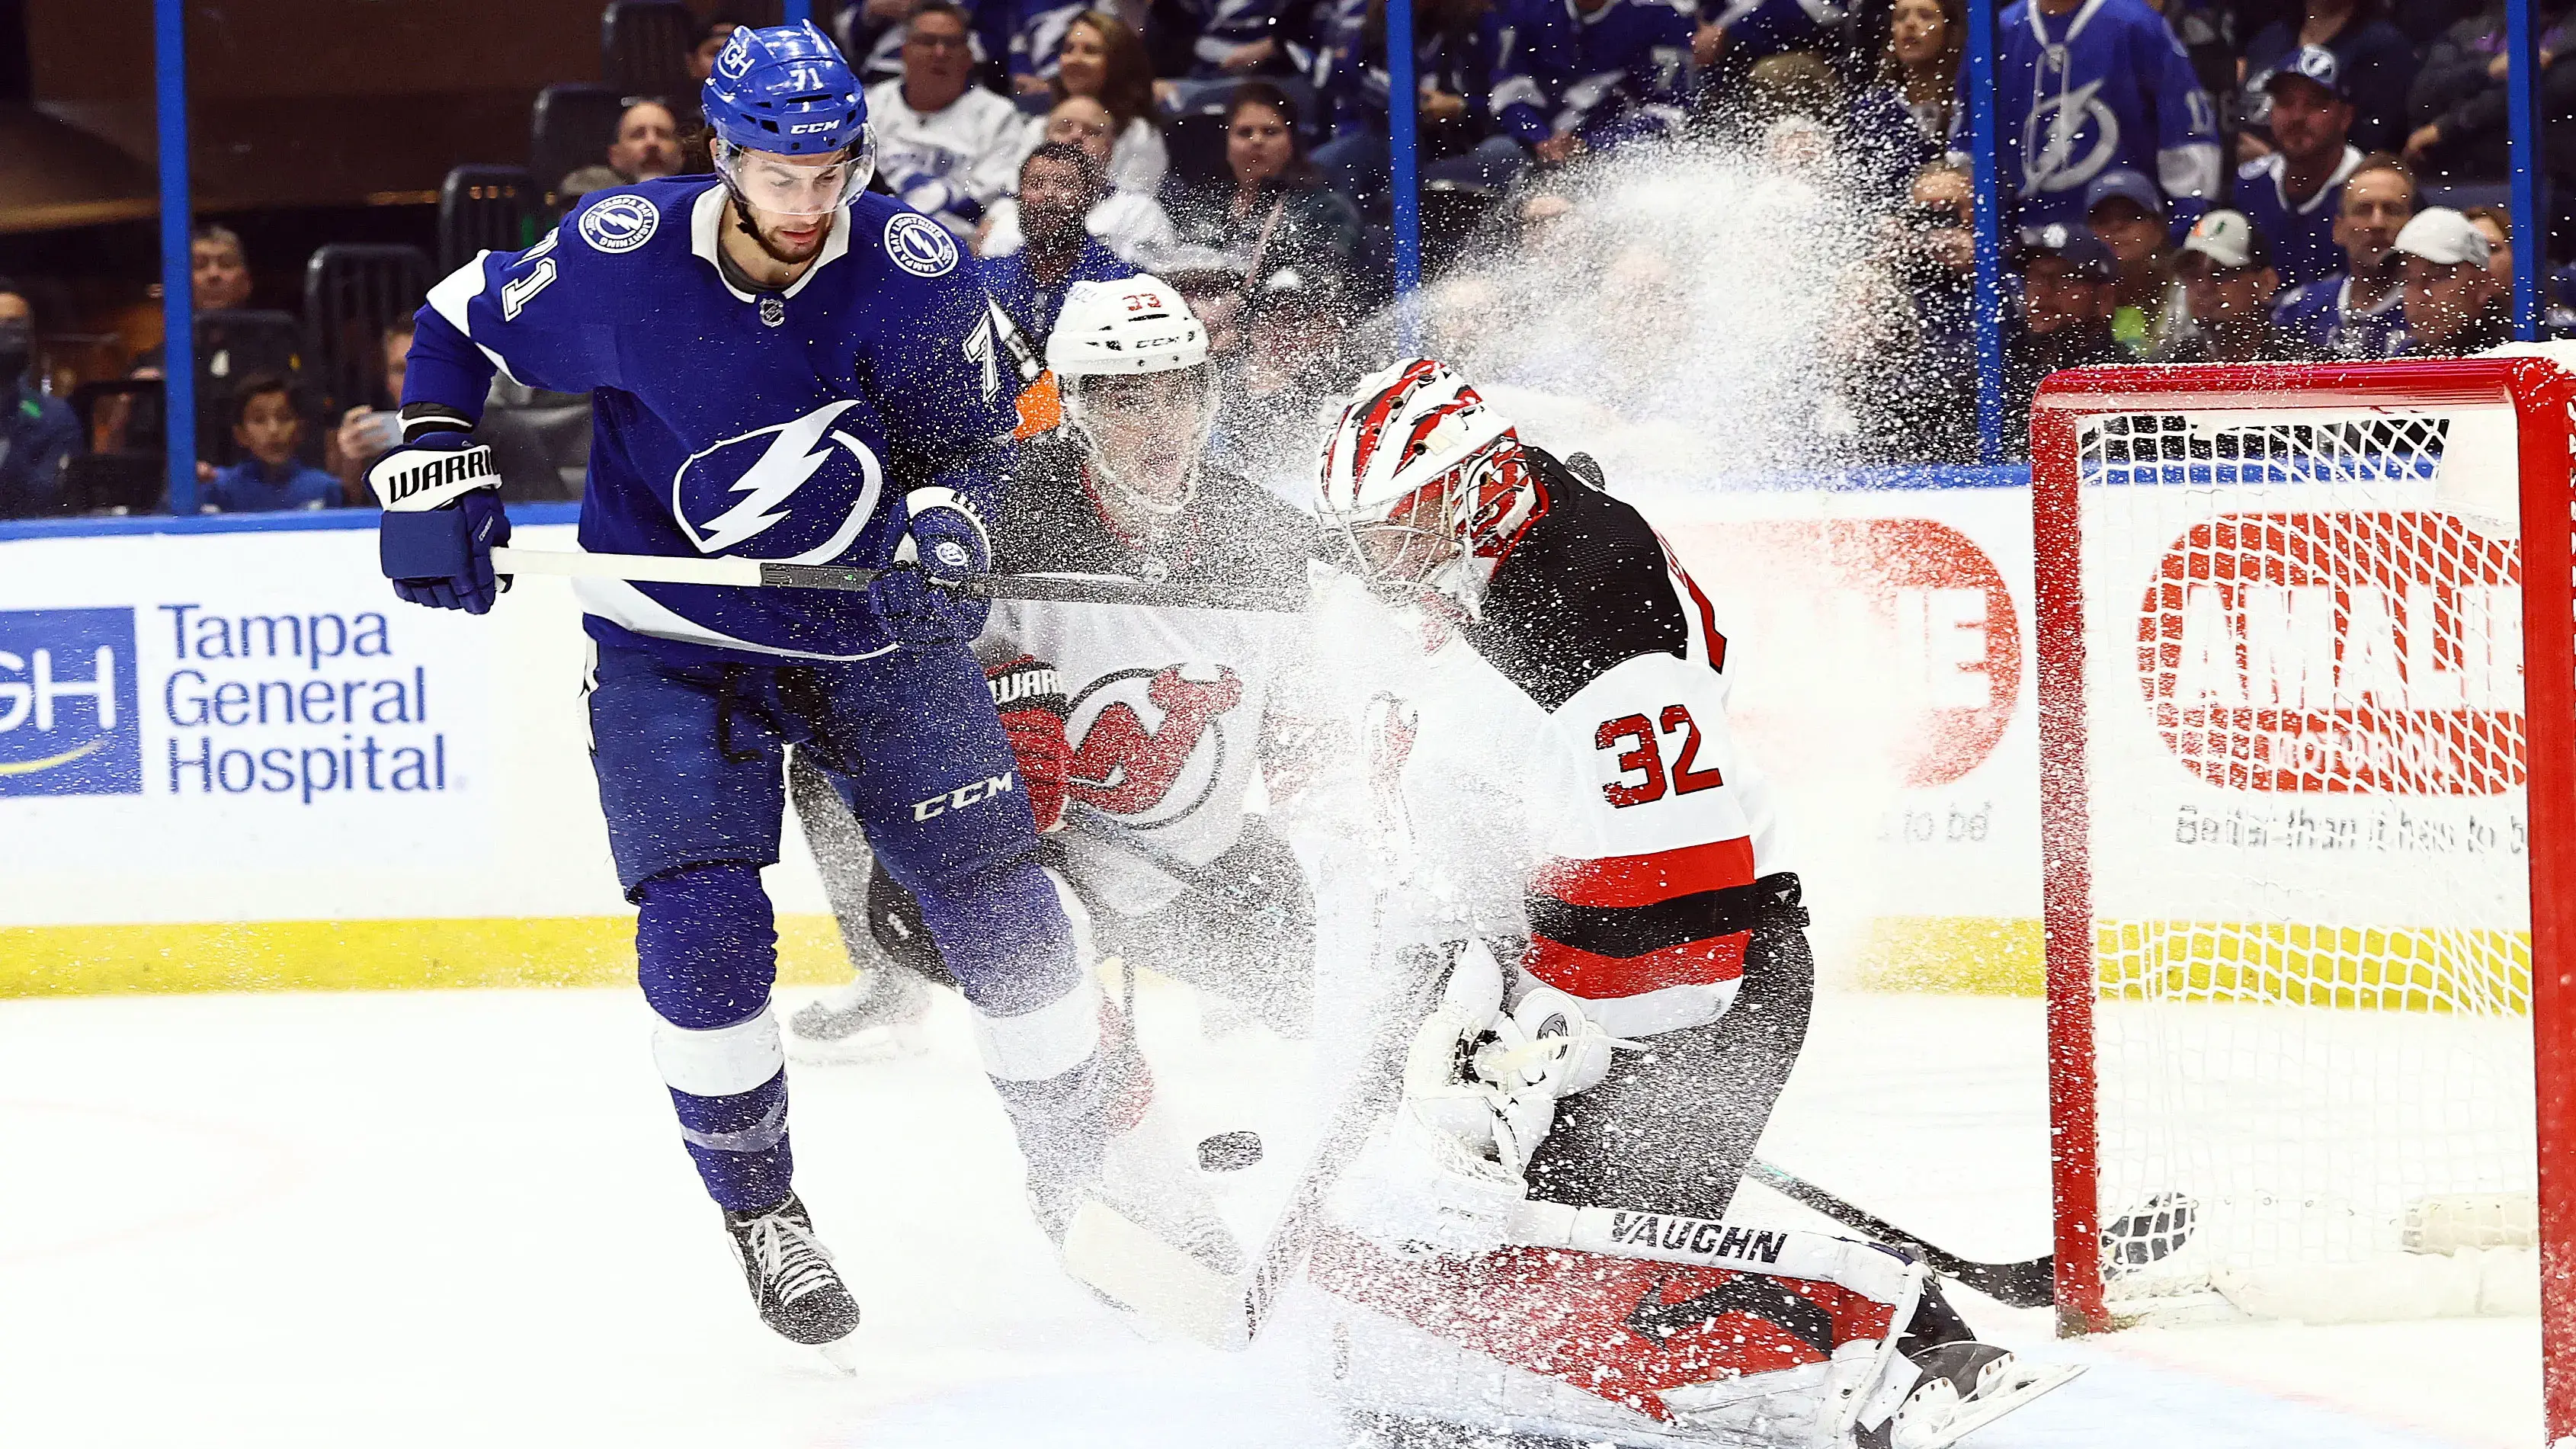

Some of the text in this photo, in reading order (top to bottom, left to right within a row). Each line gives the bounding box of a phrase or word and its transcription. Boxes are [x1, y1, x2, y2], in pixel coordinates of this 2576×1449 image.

[790, 67, 824, 91] 71
[790, 120, 840, 134] CCM
[596, 198, 637, 211] TAMPA
[636, 203, 654, 217] BAY
[598, 218, 653, 248] LIGHTNING
[890, 232, 903, 254] BAY
[892, 217, 944, 240] LIGHTNING
[900, 253, 937, 272] TAMPA
[389, 449, 496, 505] WARRI
[158, 603, 392, 669] Tampa
[165, 665, 427, 727] General
[167, 732, 447, 805] Hospital
[1594, 704, 1725, 809] 32
[910, 771, 1013, 822] CCM
[1610, 1212, 1789, 1264] VAUGHN
